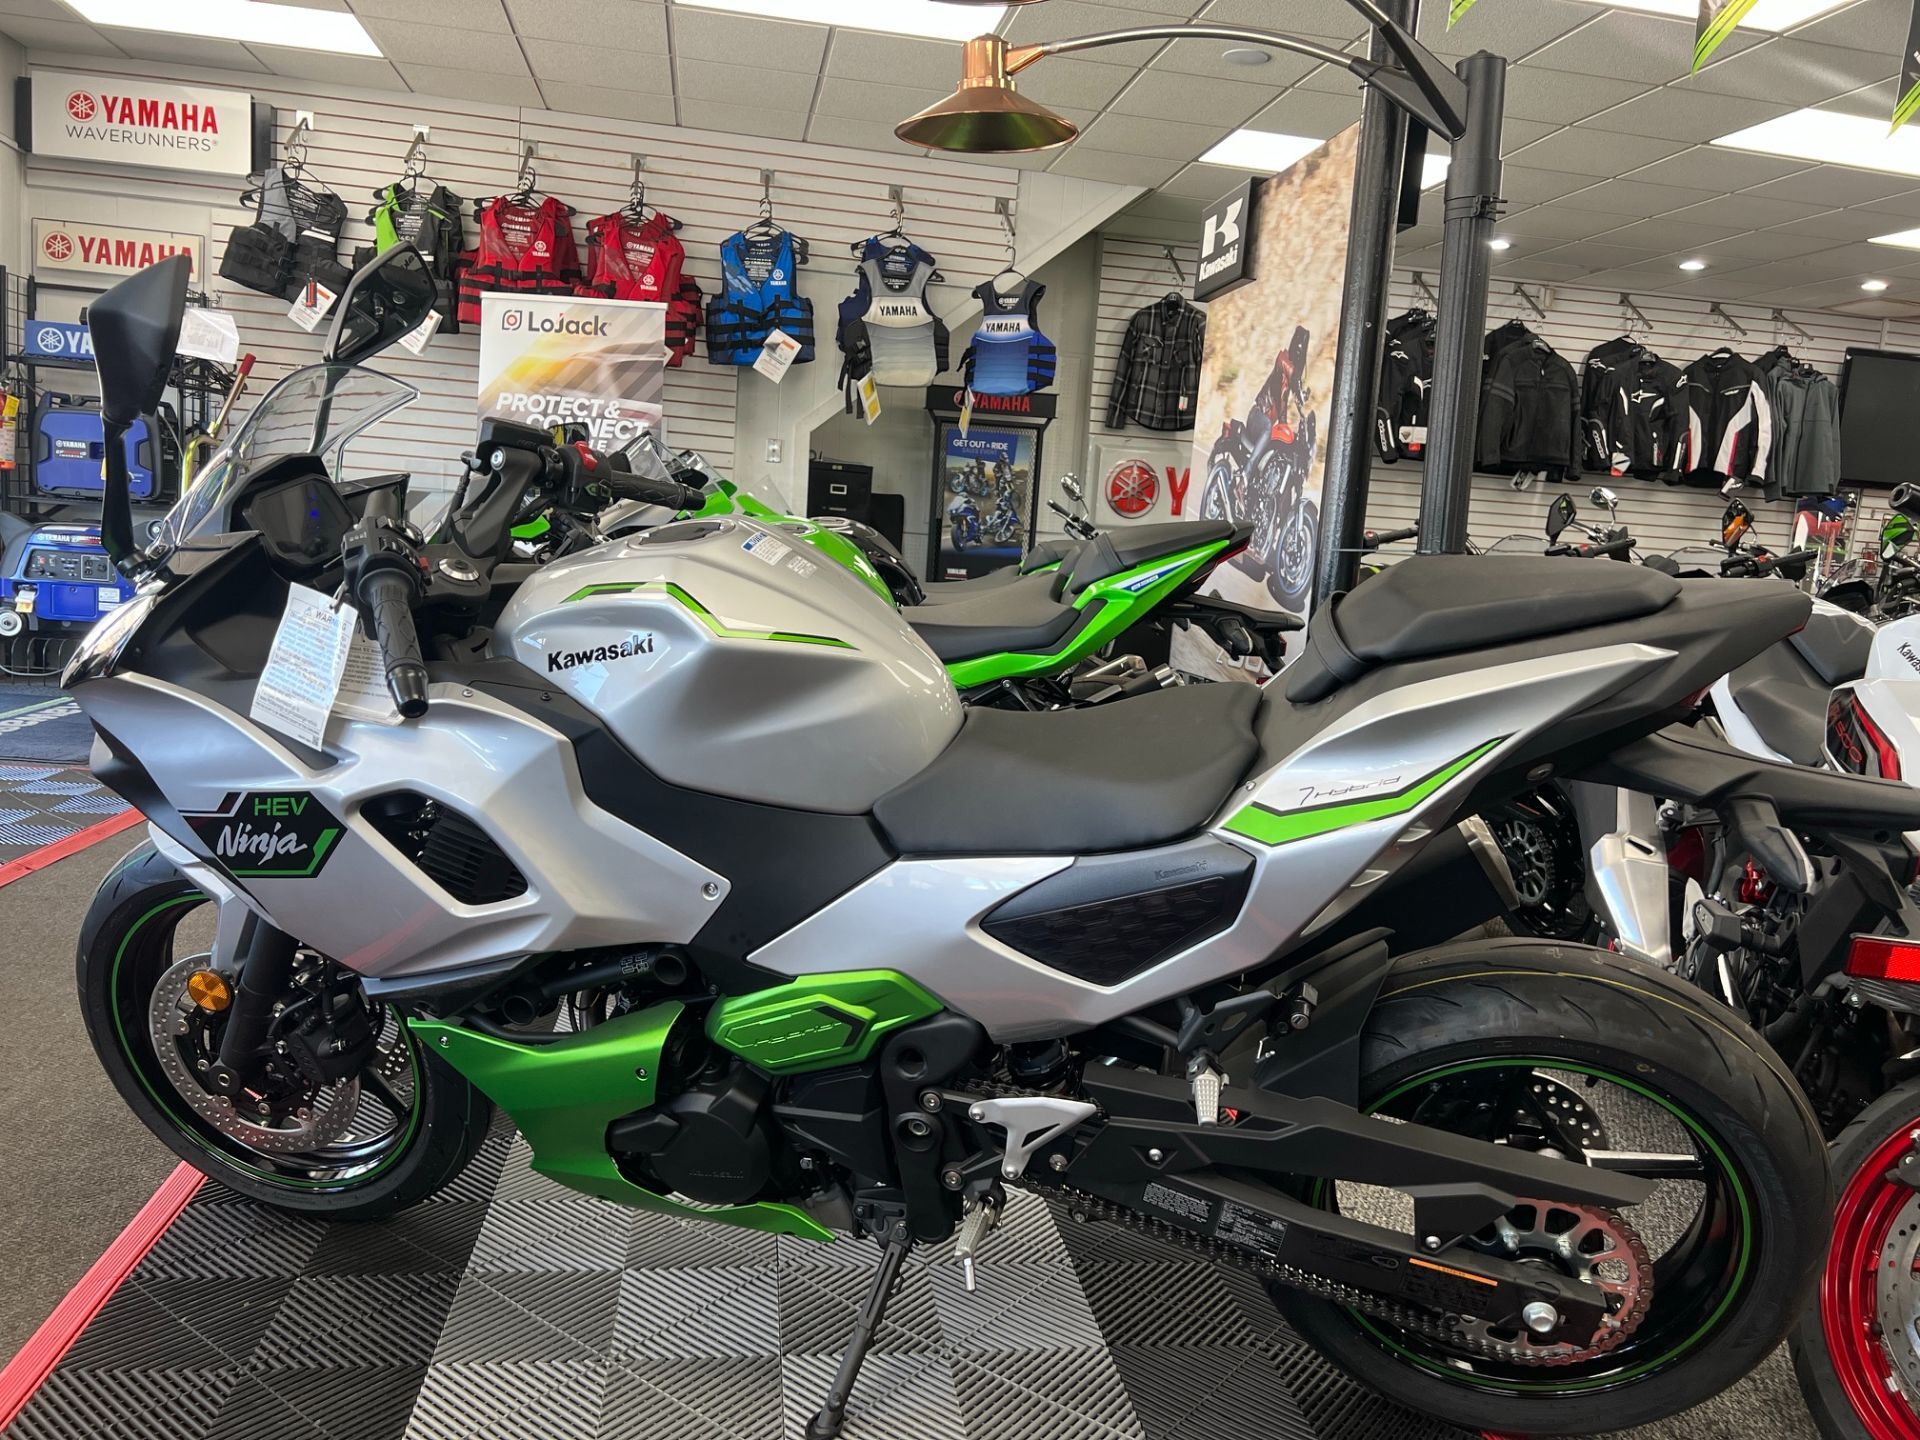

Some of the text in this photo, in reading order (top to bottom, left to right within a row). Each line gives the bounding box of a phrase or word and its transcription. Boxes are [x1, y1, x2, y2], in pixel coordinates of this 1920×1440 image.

[101, 95, 218, 134] YAMAHA
[1199, 244, 1239, 282] Kawasaki
[528, 311, 608, 336] LoJack
[880, 305, 918, 317] YAMAHA
[985, 322, 1021, 333] YAMAHA
[66, 330, 94, 354] YA
[496, 392, 621, 419] PROTECT &
[974, 394, 1031, 412] YAMAHA
[526, 413, 650, 441] CONECT
[62, 441, 86, 449] YAMAHA
[953, 439, 968, 448] GET
[969, 440, 986, 449] OUT
[991, 442, 1009, 450] RIDE
[1165, 466, 1190, 516] Y
[316, 609, 347, 632] WARNG
[548, 632, 654, 672] Kawasaki
[1896, 641, 1920, 675] Kawas
[1299, 775, 1401, 805] 7 Hybrid
[254, 797, 309, 817] HEV
[217, 822, 308, 866] Ninja
[1154, 859, 1208, 880] Kawasaki
